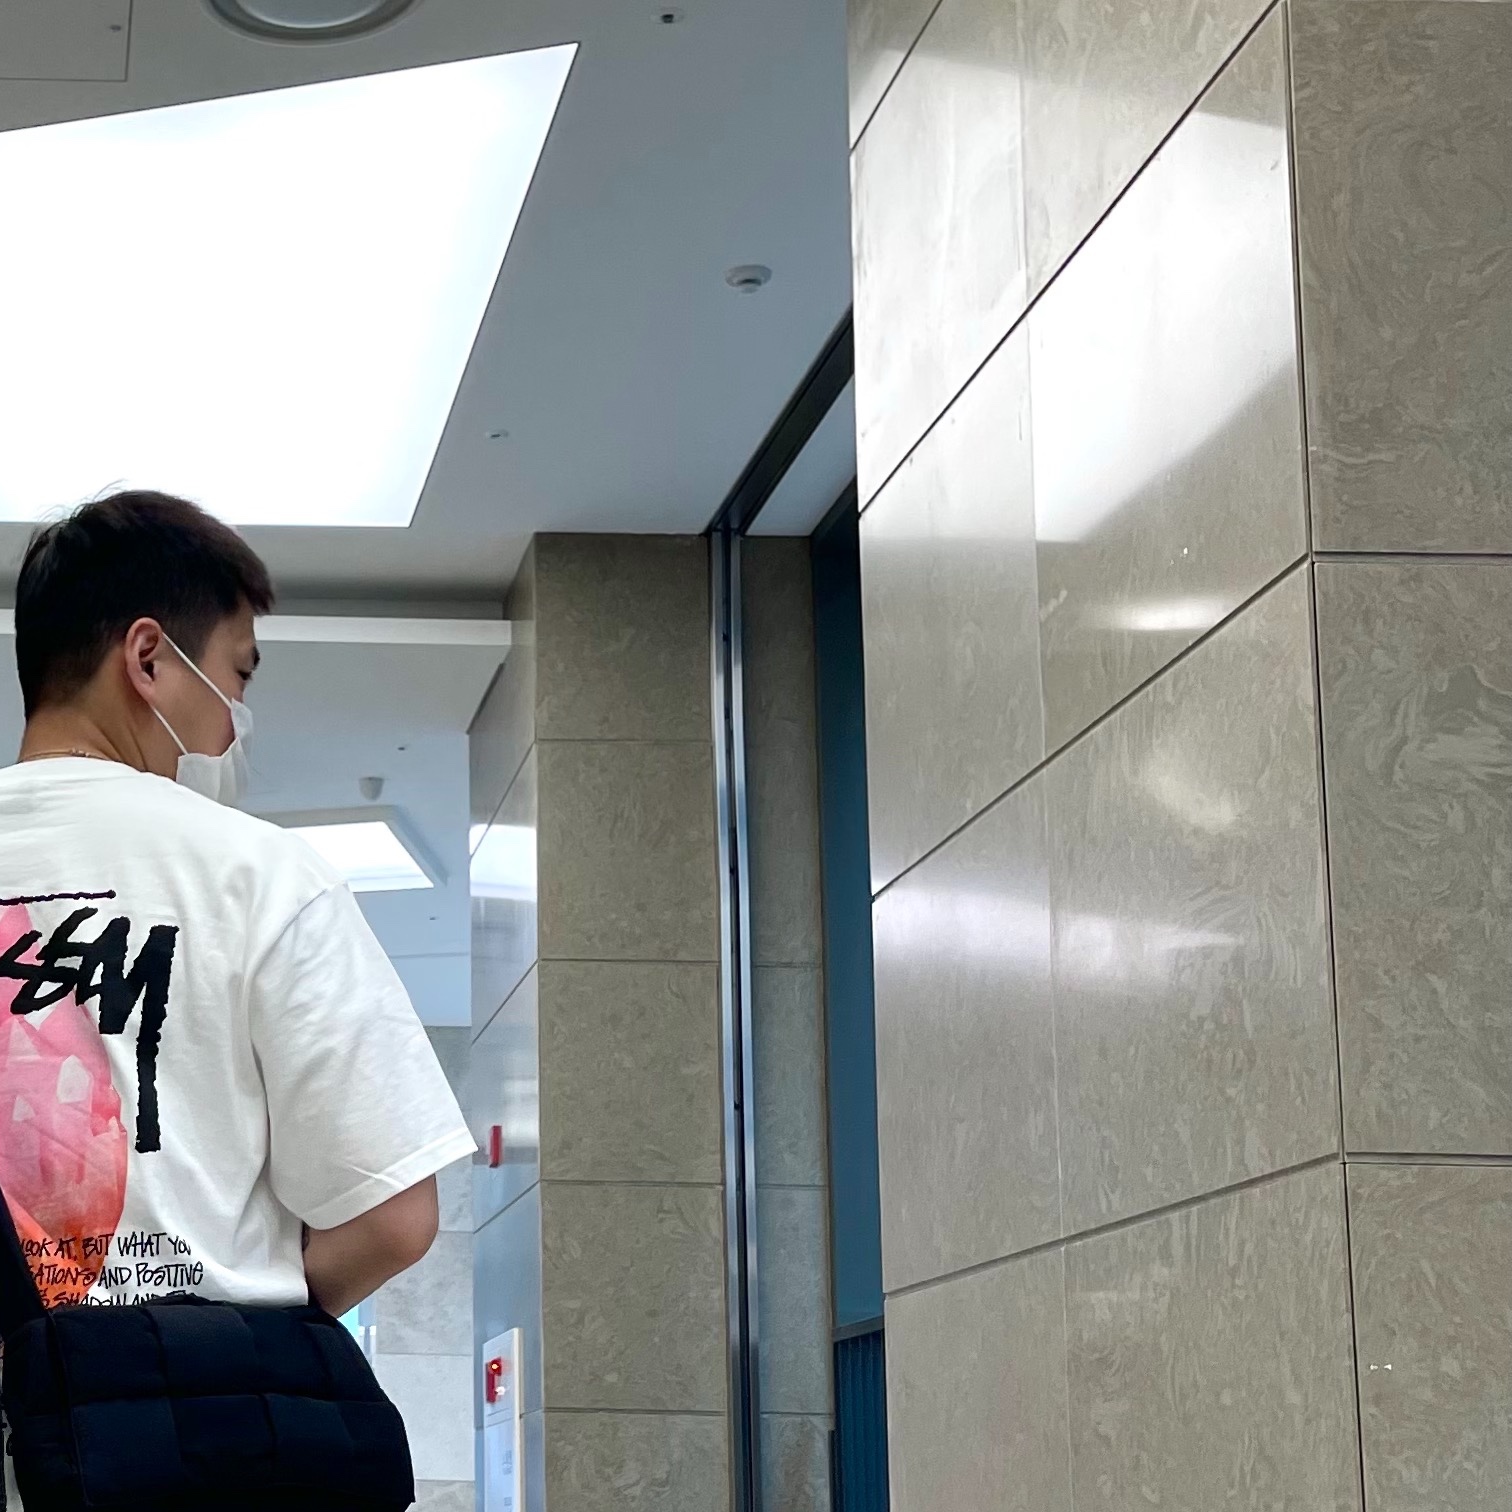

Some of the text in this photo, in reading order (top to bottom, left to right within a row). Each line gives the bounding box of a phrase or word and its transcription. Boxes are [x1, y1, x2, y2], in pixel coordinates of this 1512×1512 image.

[82, 1232, 115, 1261] BUT
[118, 1231, 168, 1258] WHAT
[168, 1236, 192, 1256] YOU
[98, 1265, 133, 1290] AND
